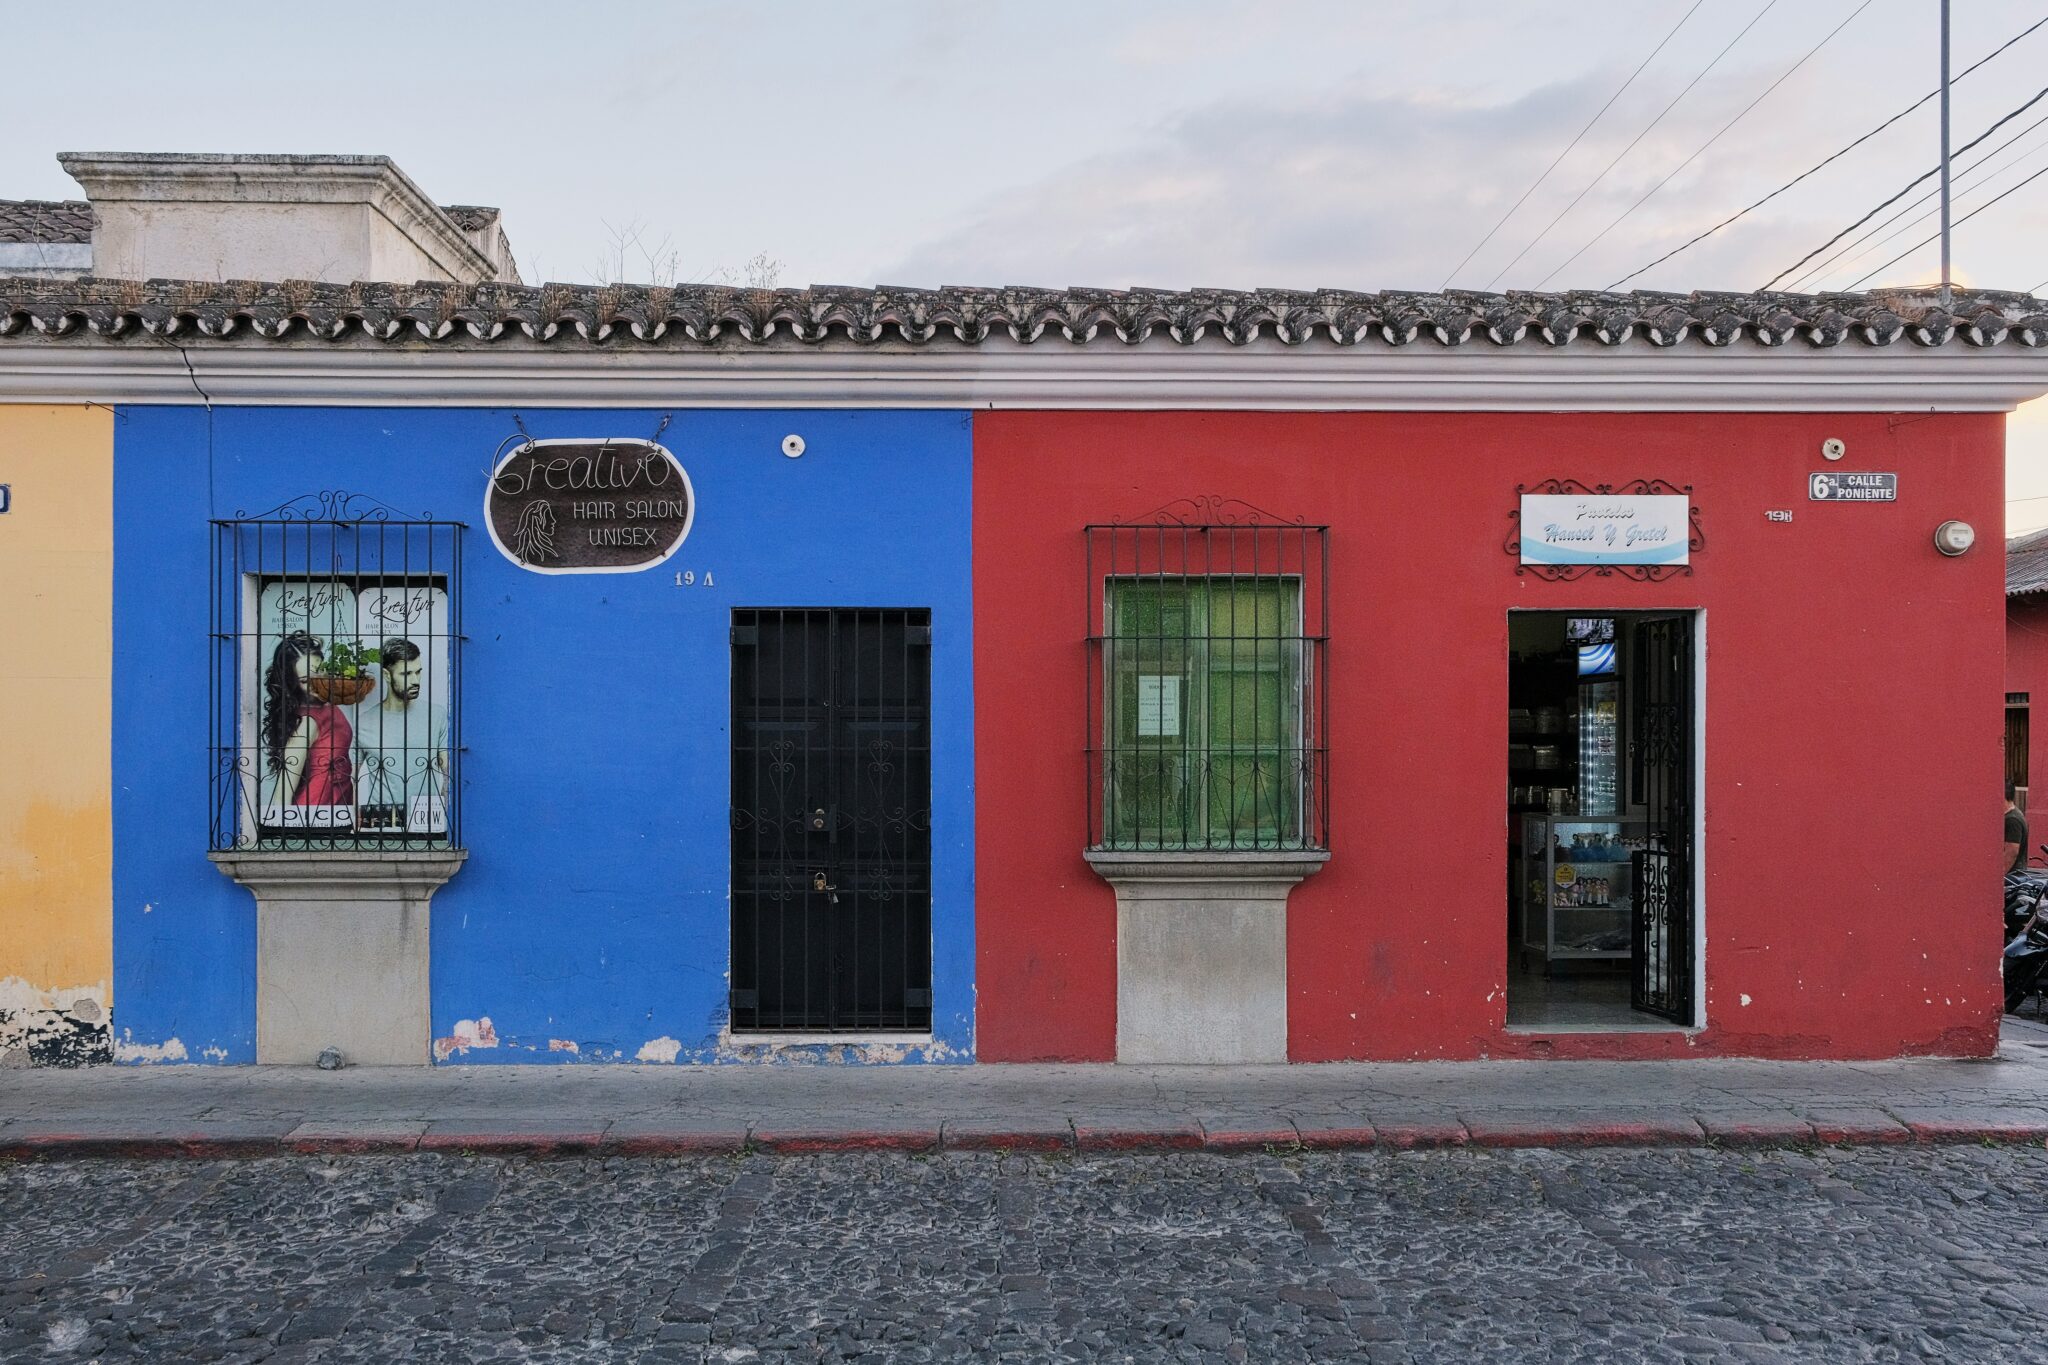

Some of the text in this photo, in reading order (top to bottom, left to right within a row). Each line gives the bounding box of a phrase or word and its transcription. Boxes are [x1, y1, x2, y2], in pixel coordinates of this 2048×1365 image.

[1848, 475, 1883, 486] CALLE
[1837, 488, 1893, 499] PONIENTE
[573, 499, 685, 520] HAIR SALON
[588, 527, 658, 546] UNISEX
[1544, 523, 1596, 543] Hansel
[1625, 523, 1668, 547] Gretel
[674, 570, 714, 586] 19 A
[262, 809, 351, 821] JOICO
